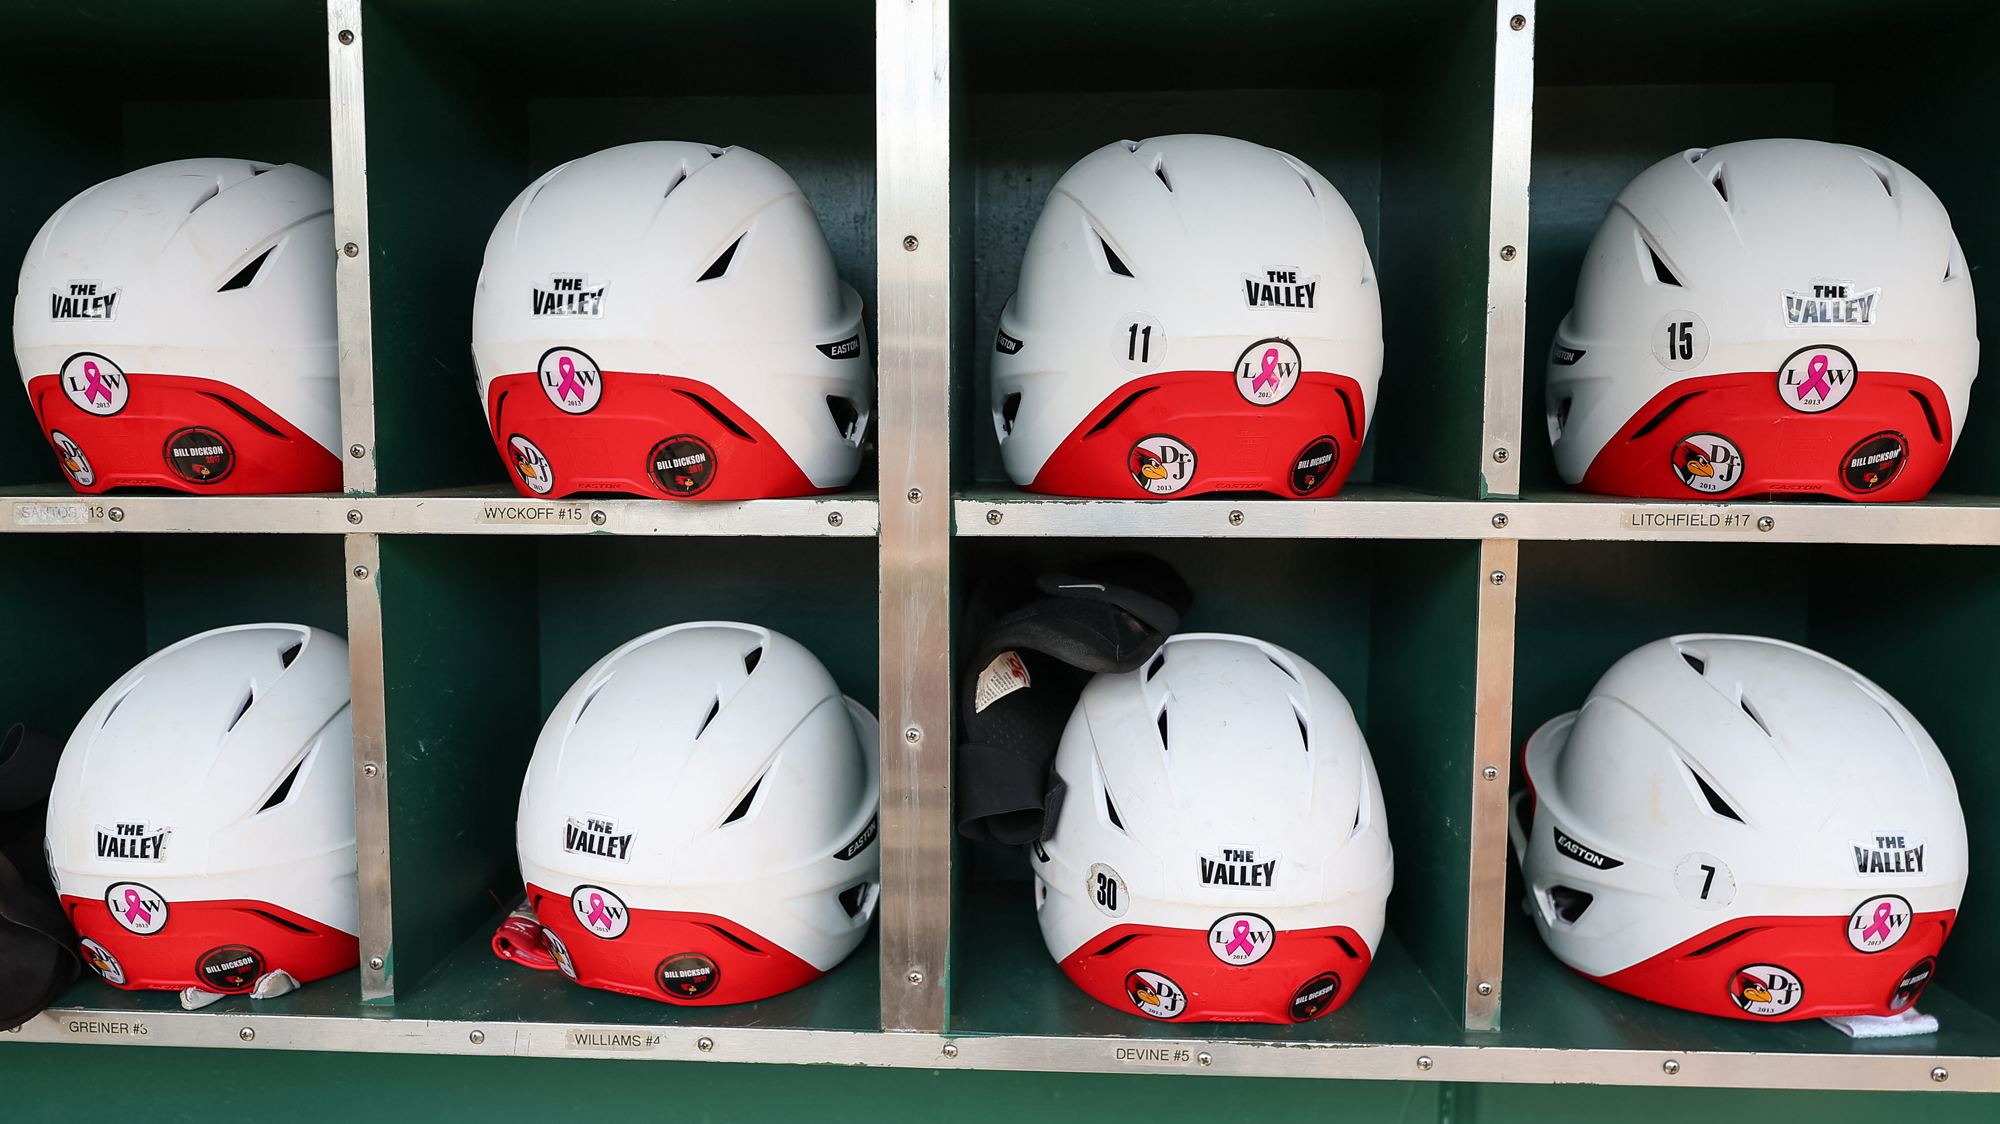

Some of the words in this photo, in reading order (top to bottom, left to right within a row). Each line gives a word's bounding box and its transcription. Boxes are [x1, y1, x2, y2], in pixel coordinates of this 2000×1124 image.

[554, 278, 582, 291] THE
[1267, 271, 1296, 283] THE
[70, 284, 97, 295] THE
[1245, 279, 1316, 308] VALLEY
[1813, 285, 1848, 298] THE
[52, 292, 117, 318] VALLEY
[533, 287, 604, 315] VALLEY
[1786, 293, 1874, 323] VALLEY
[831, 339, 859, 356] EASTON
[1129, 323, 1152, 363] 11
[1667, 321, 1693, 360] 15
[173, 448, 190, 457] BILL
[190, 446, 224, 457] DICKSON
[205, 456, 221, 464] 2017
[523, 445, 548, 467] Dr.
[1159, 446, 1191, 464] Dr.
[1310, 453, 1333, 467] DICKSON
[1709, 443, 1741, 466] Dr.
[1850, 458, 1867, 468] BILL
[1867, 449, 1899, 465] DICKSON
[656, 461, 673, 470] BILL
[672, 453, 706, 468] DICKSON
[688, 464, 704, 474] 2017
[1173, 461, 1187, 479] J
[1718, 463, 1736, 482] J
[1699, 482, 1716, 491] 2013
[484, 507, 554, 520] WYCKOFF
[558, 508, 582, 520] #15
[1631, 513, 1721, 527] LITCHFIELD
[1724, 514, 1751, 527] #17
[117, 824, 144, 836] THE
[587, 818, 614, 834] THE
[97, 830, 164, 859] VALLEY
[566, 823, 632, 860] VALLEY
[848, 820, 876, 857] EASTON
[1875, 836, 1906, 849] THE
[1223, 849, 1254, 863] THE
[1557, 835, 1604, 866] EASTON
[1854, 843, 1924, 873] VALLEY
[1200, 856, 1276, 887] VALLEY
[1700, 863, 1716, 900] 7
[1096, 872, 1117, 911] 30
[205, 964, 222, 974] BILL
[220, 956, 253, 971] DICKSON
[664, 970, 680, 979] BILL
[679, 967, 710, 978] DICKSON
[1767, 973, 1799, 991] Dr.
[1156, 981, 1183, 1001] Dr.
[1308, 984, 1334, 1001] DICKSON
[1777, 989, 1795, 1005] J
[1148, 1007, 1163, 1016] 2013
[69, 1020, 129, 1034] GREINER
[574, 1033, 642, 1047] WILLIAMS
[1116, 1048, 1169, 1061] DEVINE
[1173, 1049, 1190, 1062] #5
